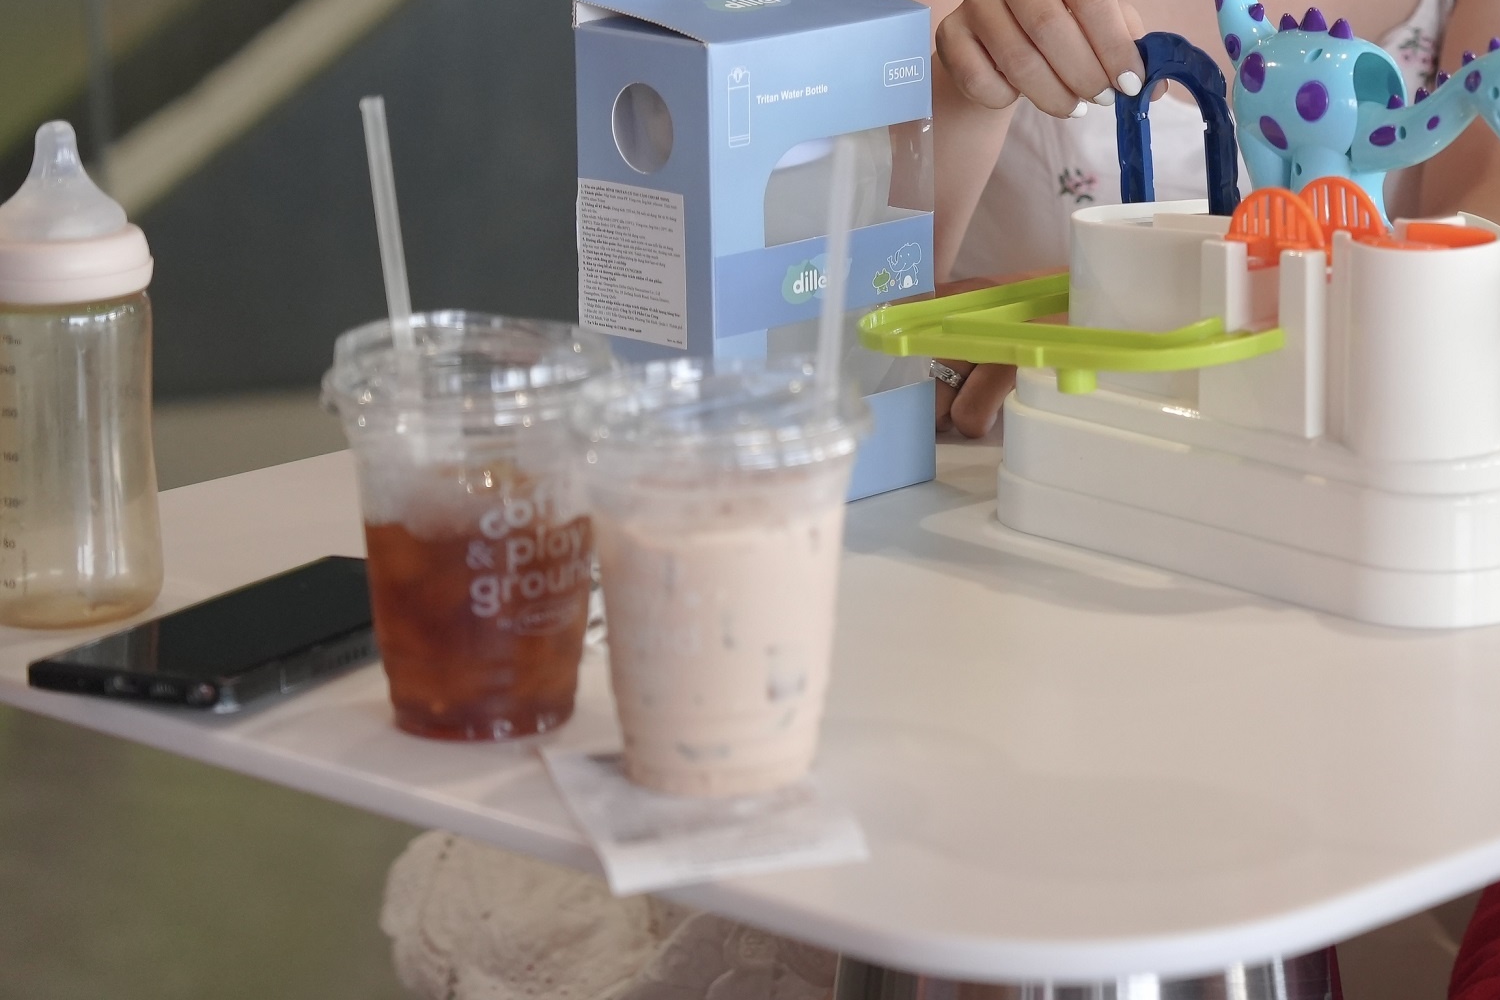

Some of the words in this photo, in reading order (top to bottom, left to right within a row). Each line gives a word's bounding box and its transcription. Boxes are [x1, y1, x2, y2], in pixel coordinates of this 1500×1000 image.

[888, 65, 919, 81] 550ML
[756, 94, 779, 105] Tritan
[781, 89, 803, 101] Water
[805, 84, 828, 97] Bottle
[793, 269, 829, 294] dille
[506, 522, 584, 576] play
[469, 557, 593, 618] groun
